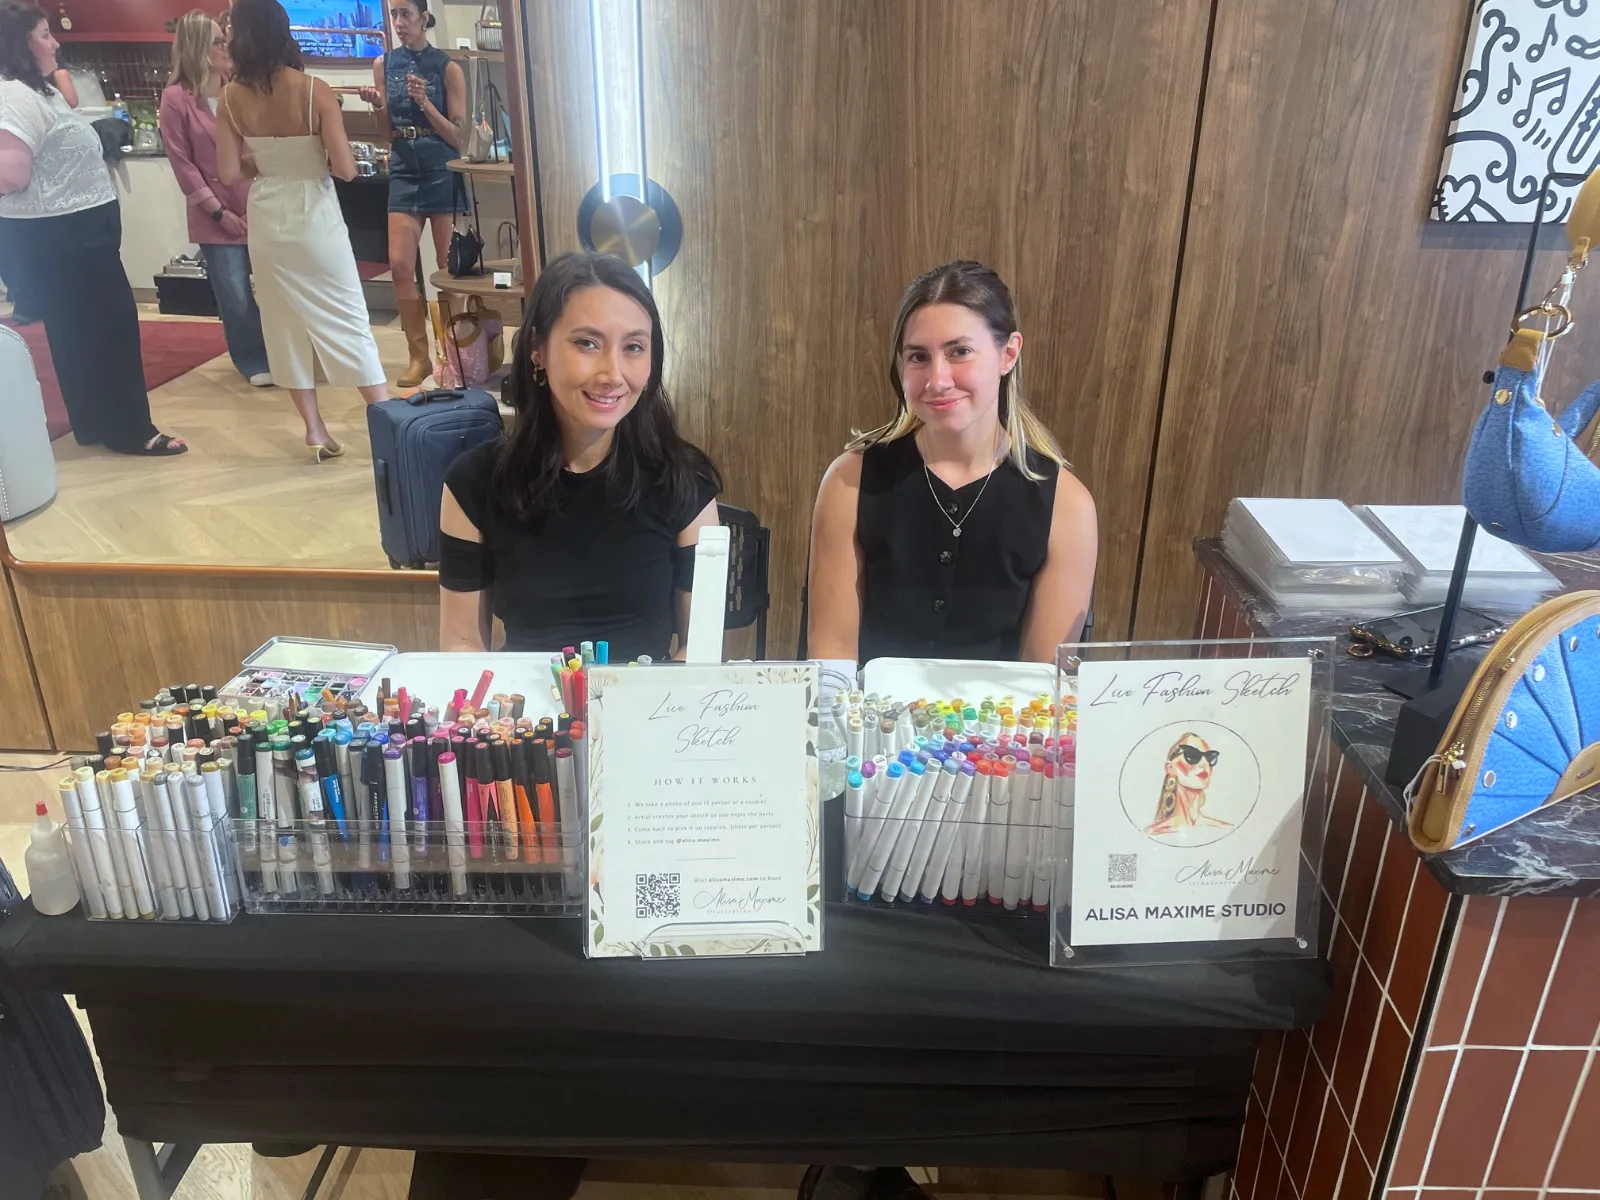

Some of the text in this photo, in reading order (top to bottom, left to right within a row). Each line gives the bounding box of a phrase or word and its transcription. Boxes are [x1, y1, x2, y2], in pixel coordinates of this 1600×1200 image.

[1142, 671, 1213, 706] Fashion
[1221, 670, 1300, 706] Sketch
[699, 689, 760, 720] Fashion
[676, 724, 741, 754] Sketch
[654, 778, 684, 786] HOW
[712, 776, 756, 784] WORKS
[1174, 856, 1282, 885] Alisa Maxime
[693, 885, 786, 911] Alisa Maxime
[1085, 902, 1286, 921] ALISA MAXIME STUDIO
